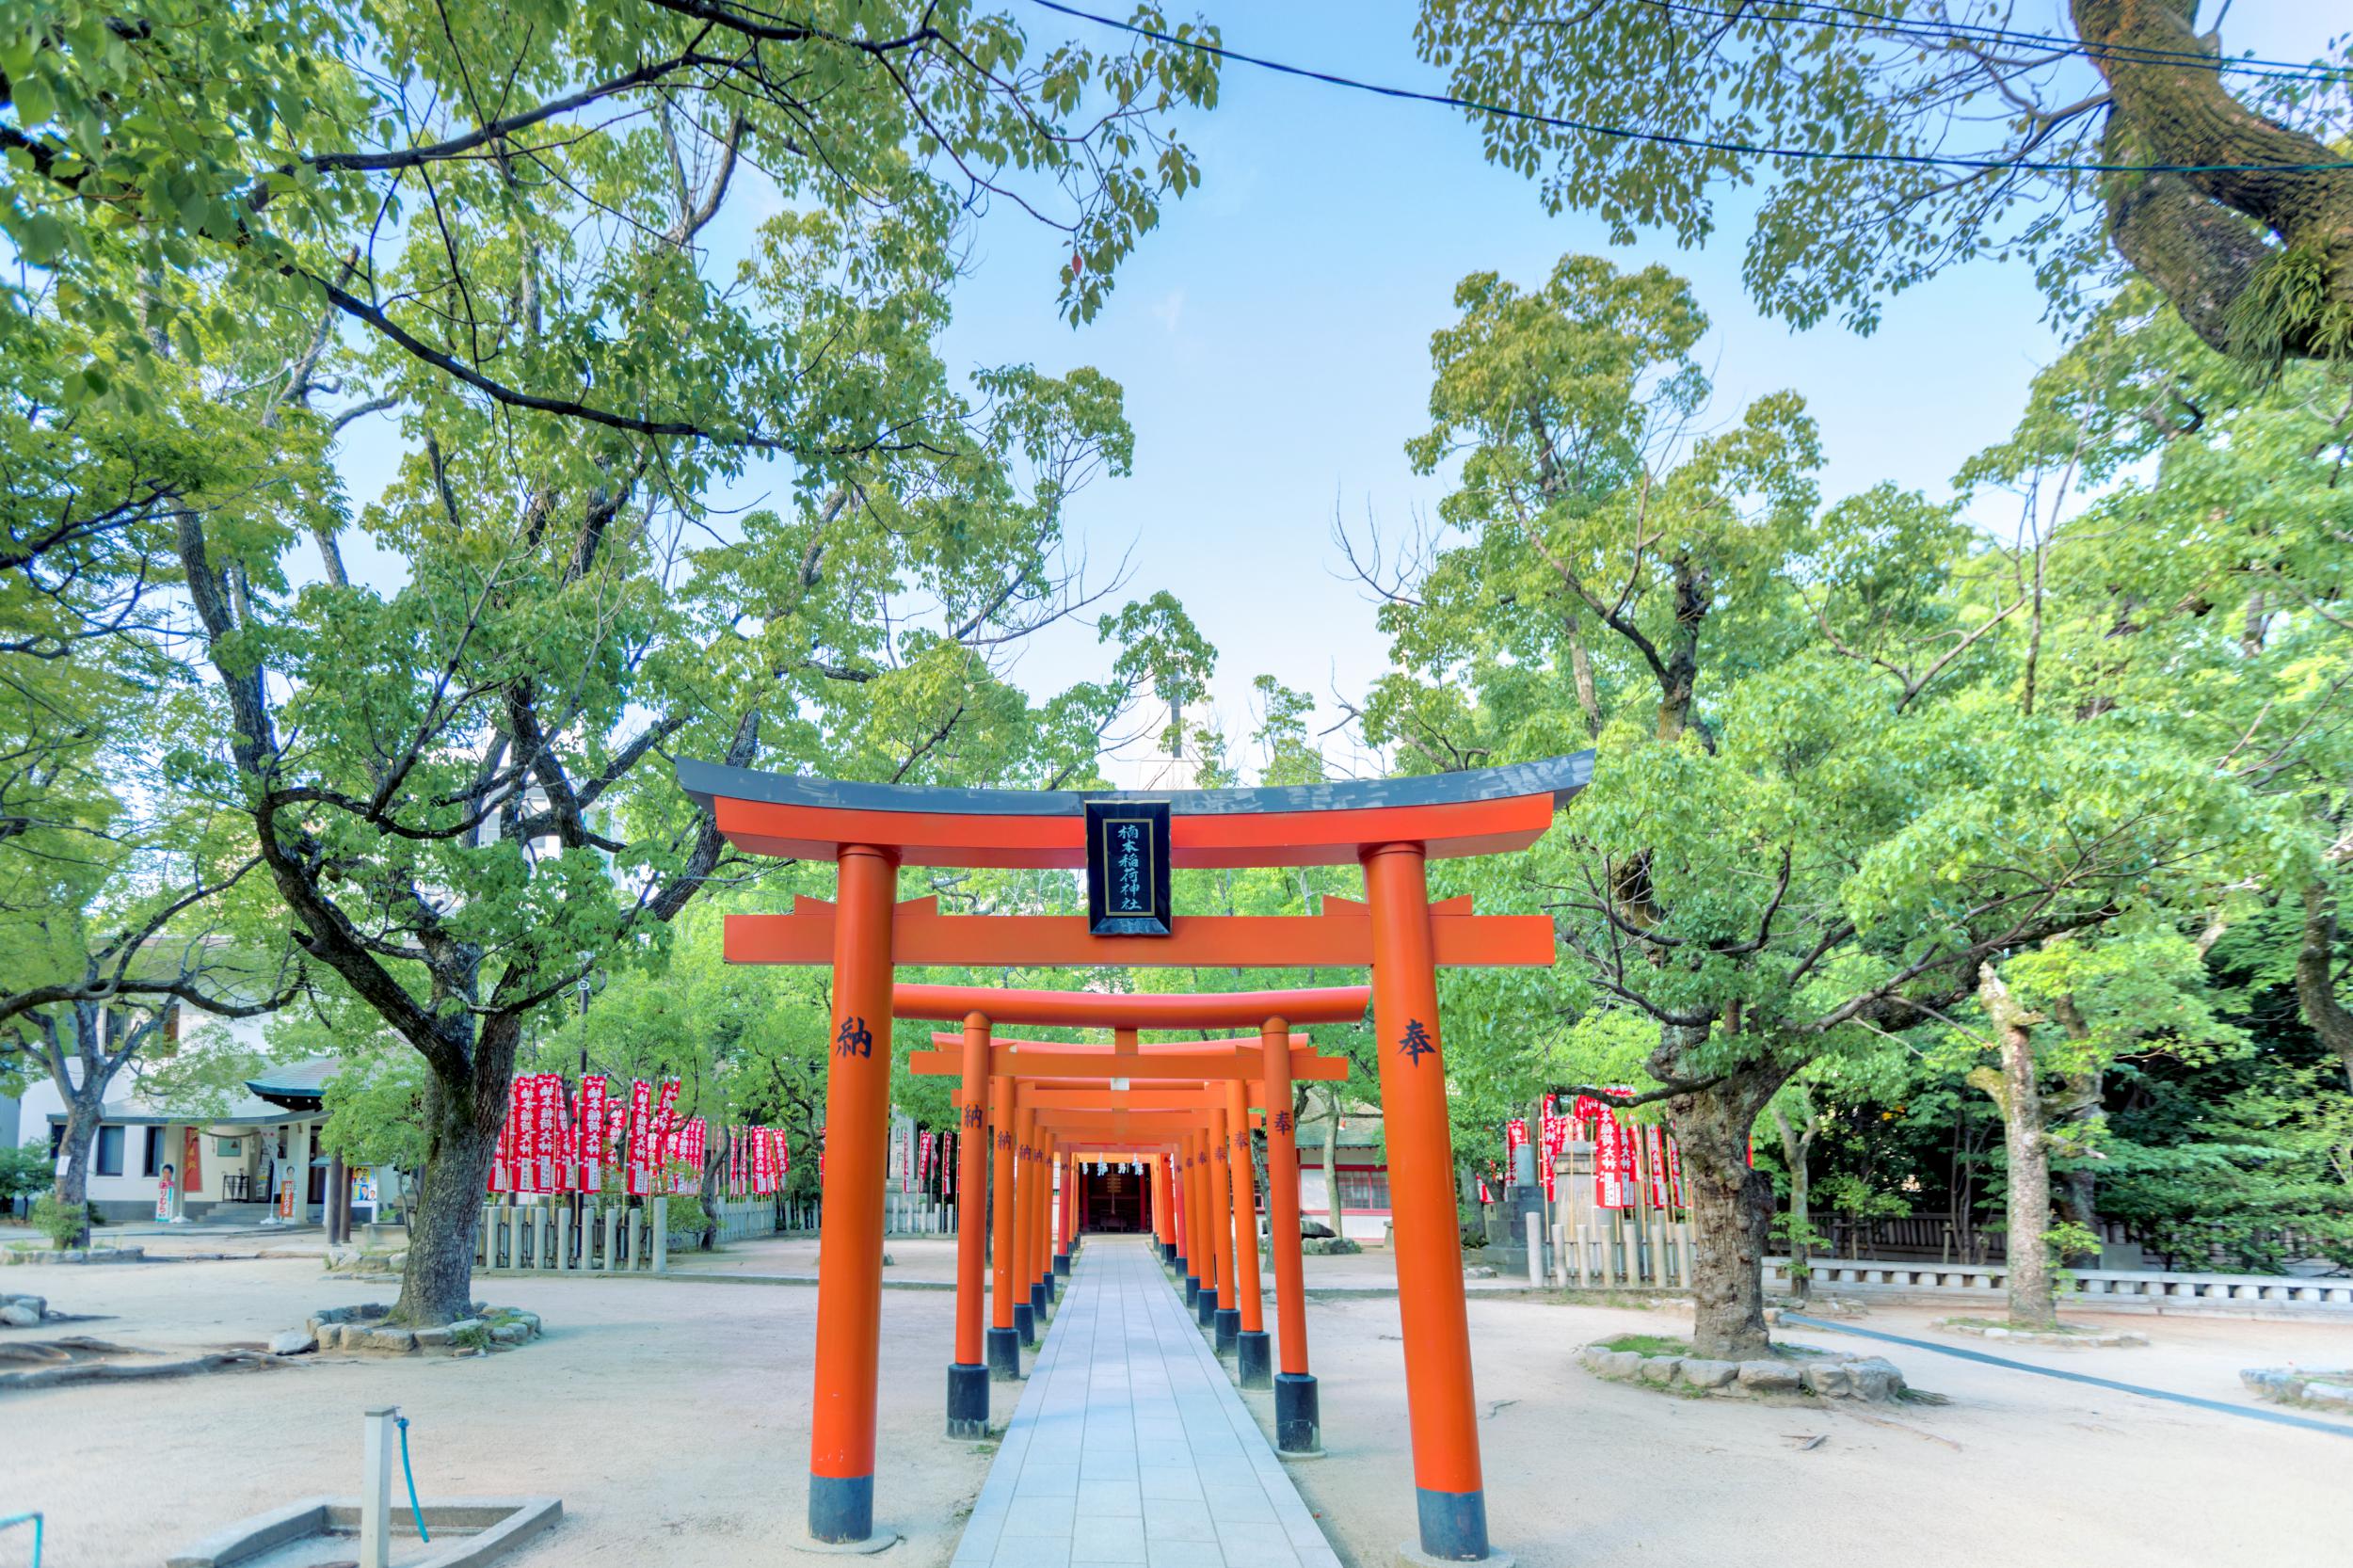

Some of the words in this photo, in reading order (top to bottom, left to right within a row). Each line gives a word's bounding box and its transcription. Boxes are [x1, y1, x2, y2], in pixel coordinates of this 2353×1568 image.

[1117, 824, 1142, 910] 楠本稲荷神社
[836, 1016, 873, 1060] 納
[1399, 1018, 1436, 1067] 奉
[965, 1104, 984, 1129] 納
[1274, 1111, 1292, 1135] 奉
[998, 1129, 1012, 1151] 納
[1234, 1130, 1249, 1151] 奉
